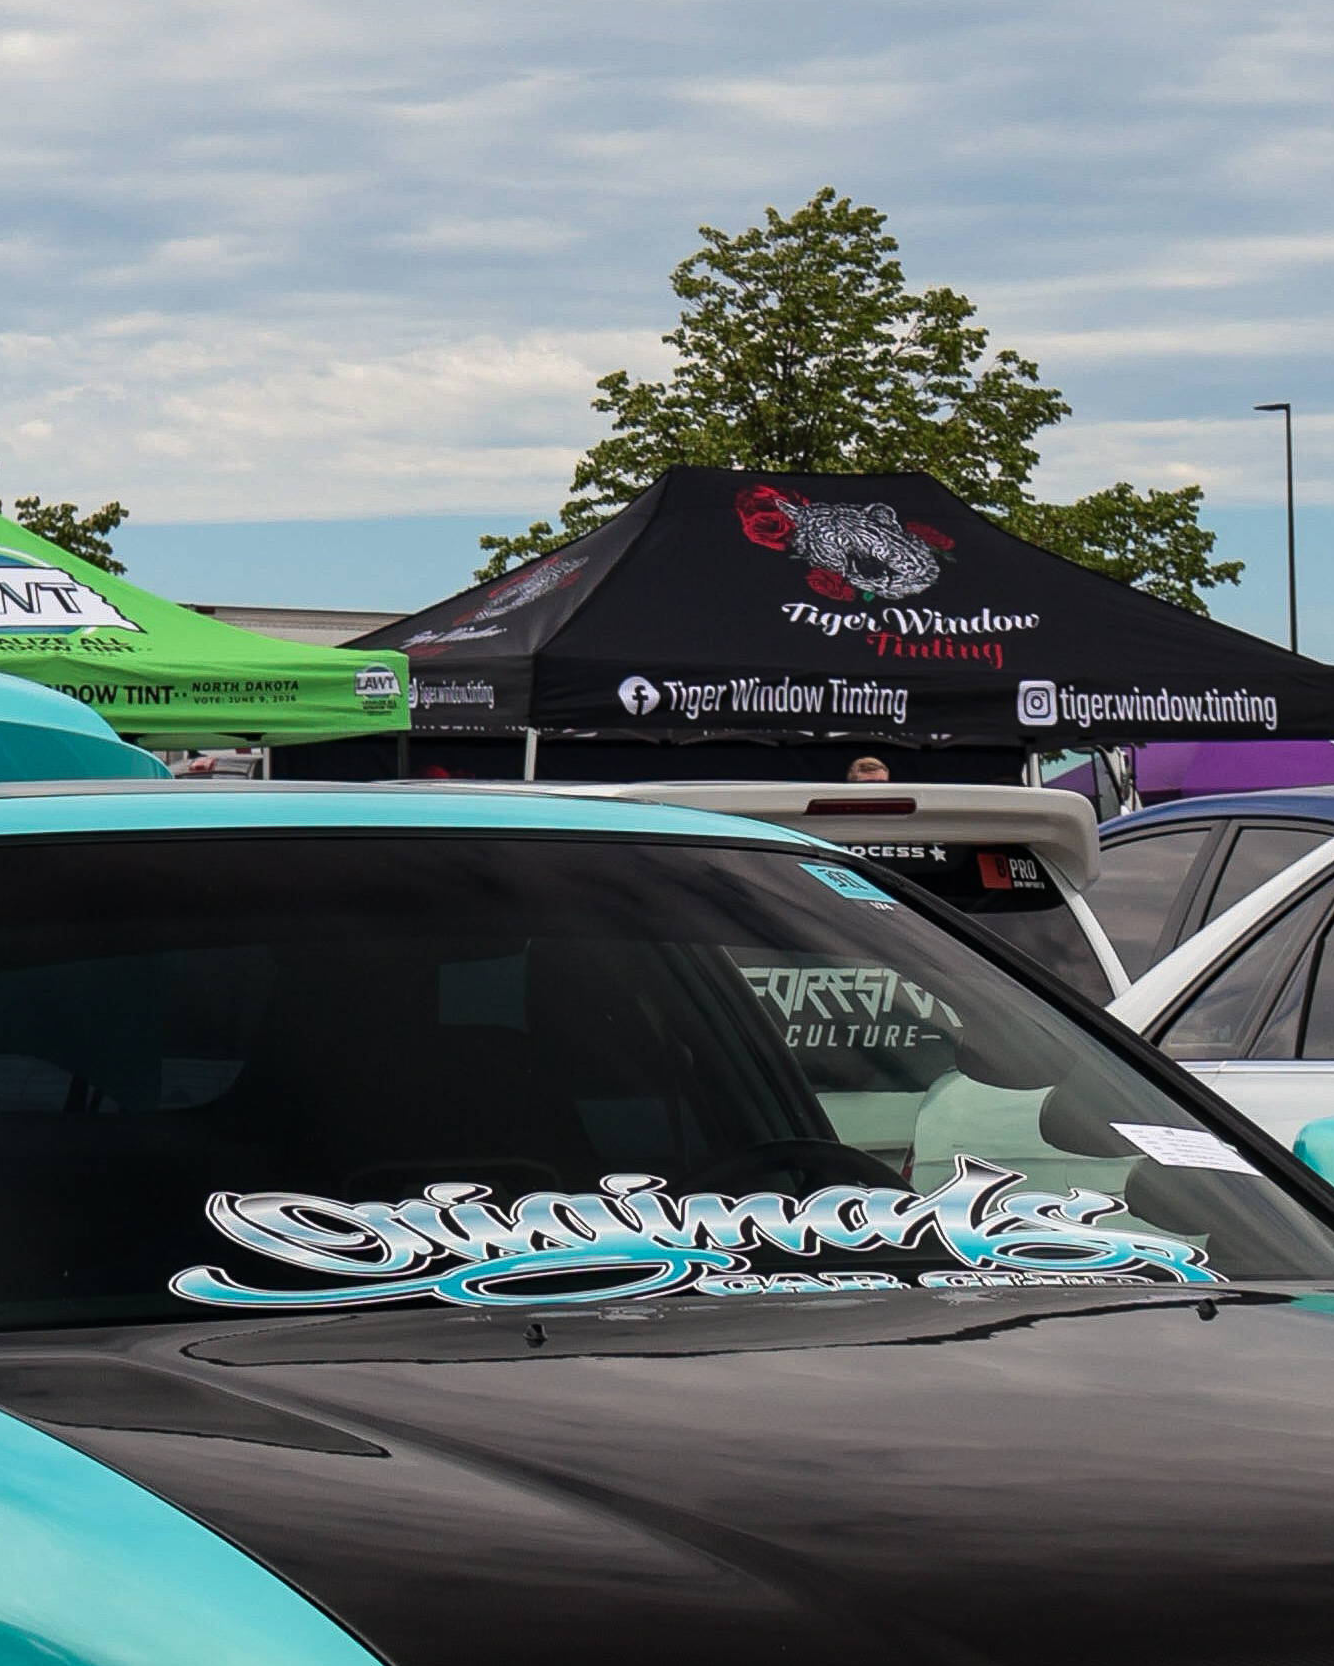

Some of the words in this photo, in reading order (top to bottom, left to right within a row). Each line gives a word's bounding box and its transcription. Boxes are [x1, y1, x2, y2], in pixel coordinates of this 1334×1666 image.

[781, 601, 881, 636] Tiger
[883, 606, 1041, 636] Window
[79, 636, 129, 646] ALL
[866, 632, 1003, 670] Tinting
[45, 684, 118, 705] DOW
[123, 685, 175, 705] TINT
[191, 681, 240, 693] NORTH
[244, 680, 299, 692] DAKOTA
[663, 680, 727, 720] Tiger
[730, 676, 824, 714] Window
[828, 678, 909, 724] Tinting
[1059, 685, 1278, 730] tiger.window.tinting
[847, 845, 925, 859] OCESS
[1008, 858, 1037, 880] PRO
[785, 1023, 918, 1048] CULTURE
